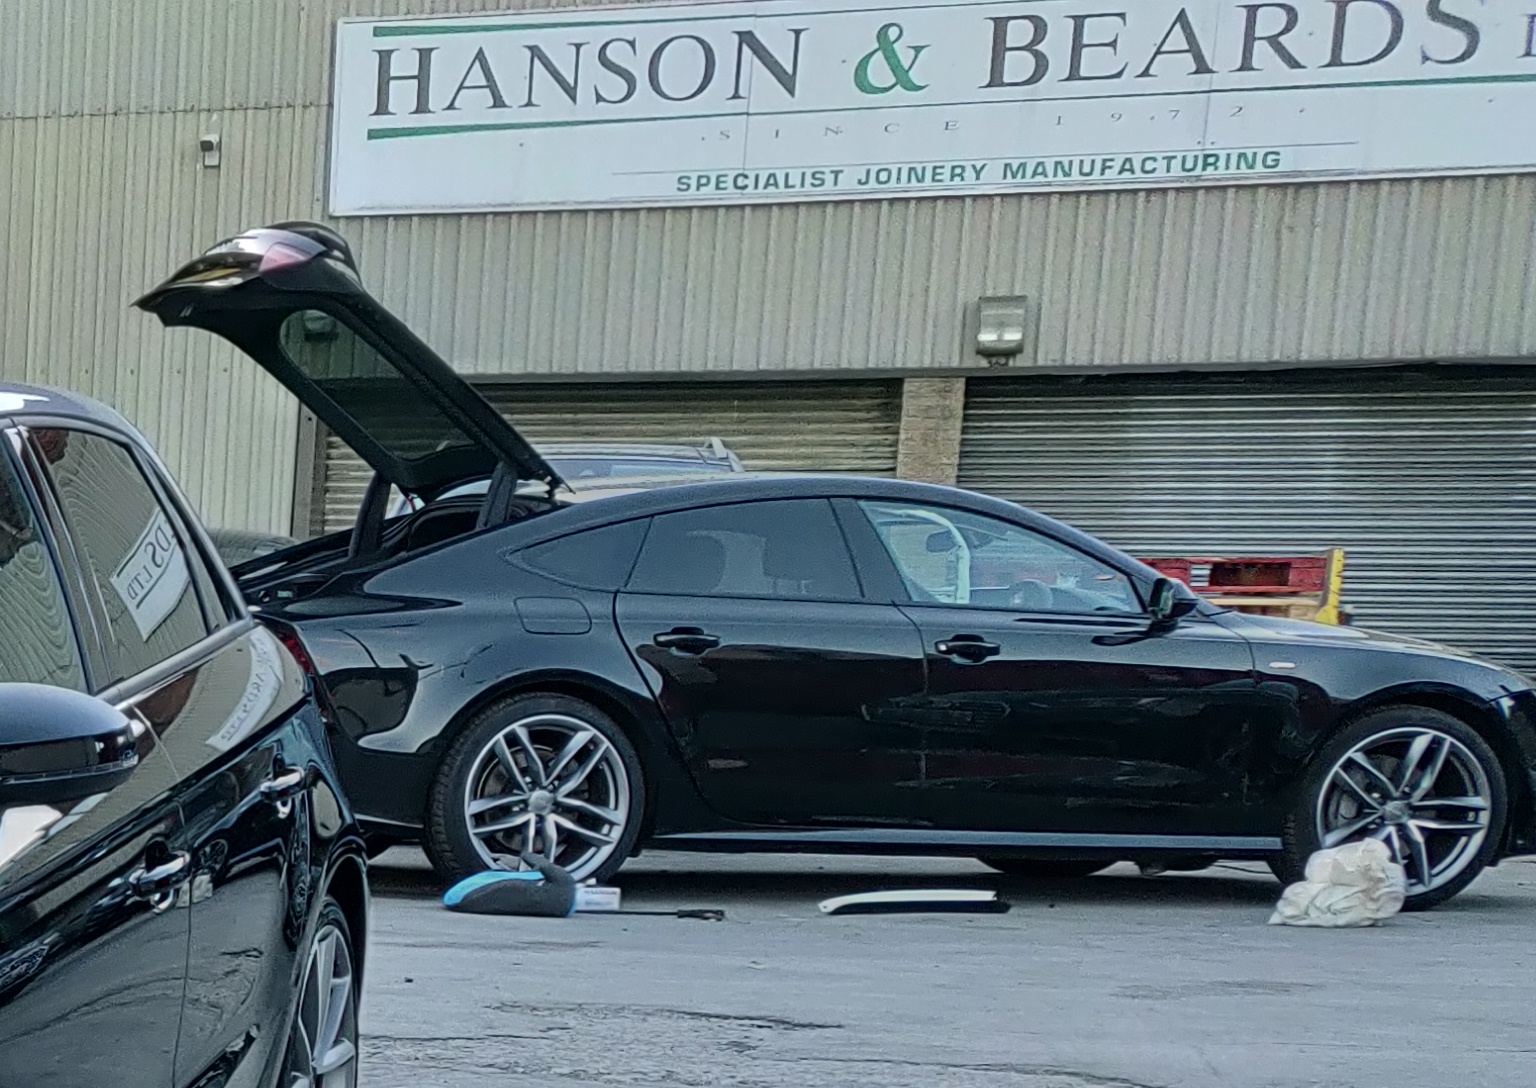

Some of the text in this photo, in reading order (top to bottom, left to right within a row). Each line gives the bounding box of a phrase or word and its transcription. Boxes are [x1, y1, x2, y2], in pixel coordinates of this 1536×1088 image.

[369, 28, 810, 117] HANSON
[853, 22, 932, 95] &
[978, 0, 1480, 89] BEARDS
[719, 105, 1244, 141] SINCE 1972
[676, 150, 1283, 193] SPECIALIST JOINERY MANUFACTURING
